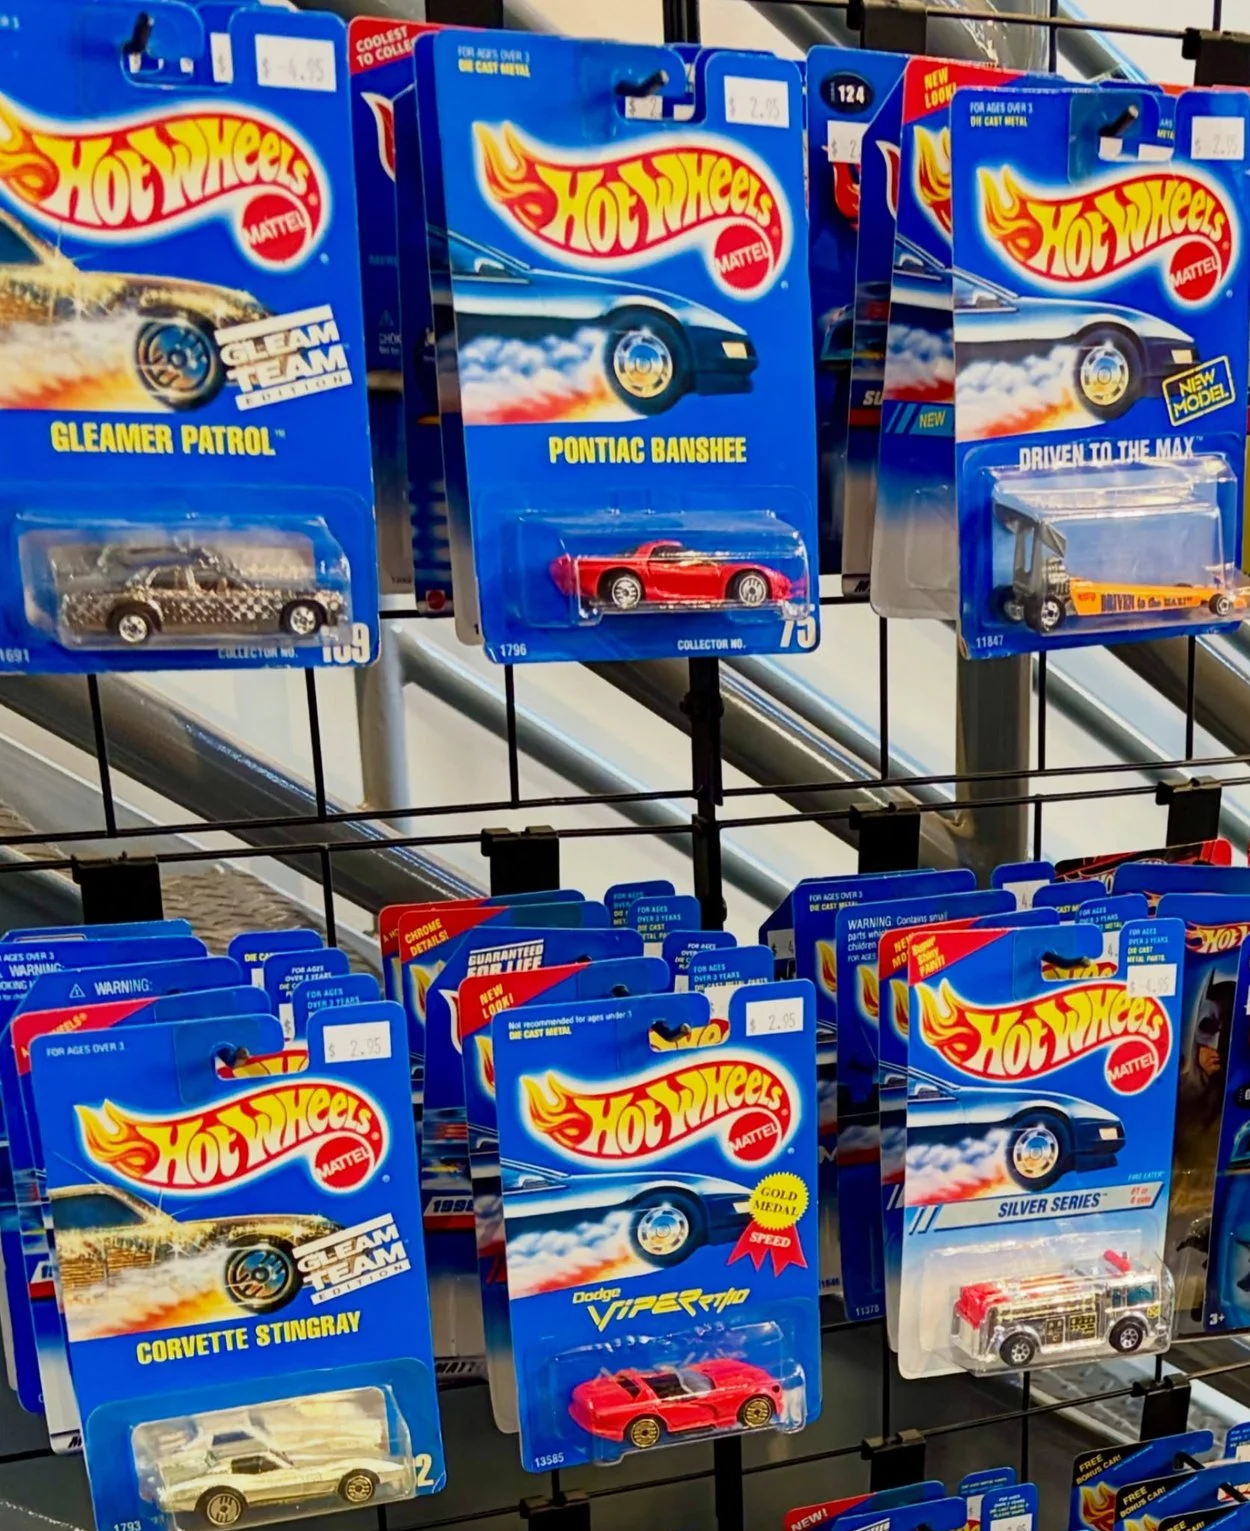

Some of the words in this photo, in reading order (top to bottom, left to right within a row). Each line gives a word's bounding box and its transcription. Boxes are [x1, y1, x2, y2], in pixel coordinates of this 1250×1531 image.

[355, 26, 409, 53] COOLEST
[924, 67, 949, 90] NEW
[838, 85, 866, 104] 124
[243, 211, 307, 247] MATTEL
[714, 242, 770, 275] MATTEL
[1169, 257, 1218, 289] MATTEL
[220, 320, 341, 368] GLEAM
[227, 346, 349, 393] TEAM
[1177, 368, 1217, 396] NEW
[1172, 386, 1230, 419] MODEL
[918, 410, 946, 429] NEW
[51, 421, 173, 455] GLEAMER
[181, 425, 276, 456] PATROL
[549, 436, 644, 465] PONTIAC
[651, 436, 748, 465] BANSHEE
[1019, 446, 1084, 470] DRIVEN
[1089, 443, 1113, 464] TO
[1117, 440, 1150, 461] THE
[1155, 437, 1194, 459] MAX
[779, 603, 817, 650] 75
[500, 643, 527, 658] 1796
[677, 639, 729, 651] COLLECTOR
[730, 639, 747, 650] NO.
[975, 634, 1005, 650] 11847
[405, 918, 443, 946] CHROME
[848, 917, 894, 931] WARNING:
[896, 914, 928, 927] Contains
[929, 912, 949, 924] small
[409, 930, 450, 957] DETAILS!
[468, 943, 545, 967] GUARANTEED
[94, 977, 154, 997] WARNING:
[480, 983, 504, 1004] NEW
[482, 992, 514, 1019] LOOK!
[508, 1021, 521, 1031] Not
[522, 1015, 574, 1030] recommended
[575, 1015, 586, 1025] for
[587, 1013, 603, 1026] ages
[604, 1012, 625, 1023] under
[46, 1046, 63, 1057] FOR
[64, 1045, 91, 1056] AGES
[92, 1043, 117, 1054] OVER
[118, 1042, 125, 1052] 3
[1107, 1053, 1156, 1083] MATTEL
[728, 1122, 780, 1152] MATTEL
[315, 1145, 373, 1182] MATTEL
[760, 1185, 799, 1204] GOLD
[998, 1198, 1049, 1219] SILVER
[1050, 1192, 1101, 1214] SERIES
[753, 1198, 801, 1219] MEDAL
[297, 1223, 400, 1273] GLEAM
[748, 1231, 793, 1249] SPEED
[302, 1240, 407, 1293] TEAM
[572, 1287, 621, 1304] Dodge
[136, 1327, 249, 1366] CORVETTE
[255, 1311, 362, 1347] STINGRAY
[534, 1452, 565, 1468] 13585
